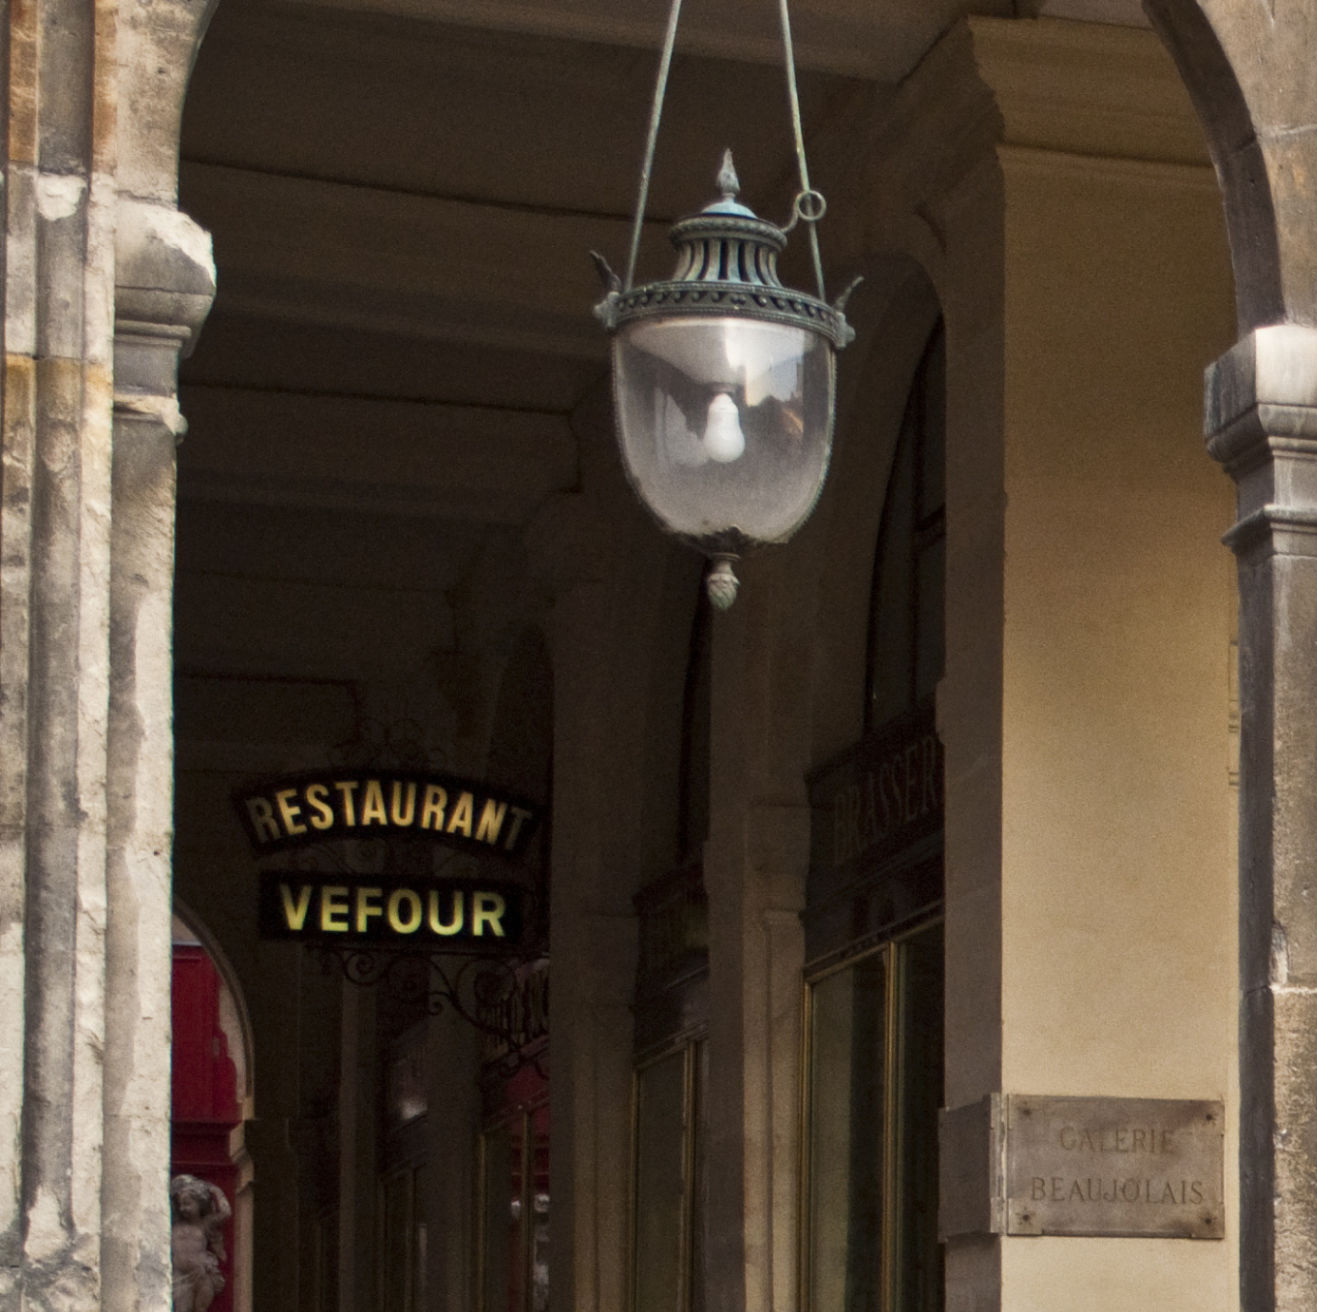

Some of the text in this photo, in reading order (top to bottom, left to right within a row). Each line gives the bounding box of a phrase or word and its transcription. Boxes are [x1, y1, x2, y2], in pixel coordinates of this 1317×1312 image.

[246, 779, 532, 851] RESTAURANT
[279, 883, 506, 937] VEFOUR
[1059, 1126, 1176, 1153] GALERIE
[1031, 1177, 1204, 1205] BEAUJOLAIS
